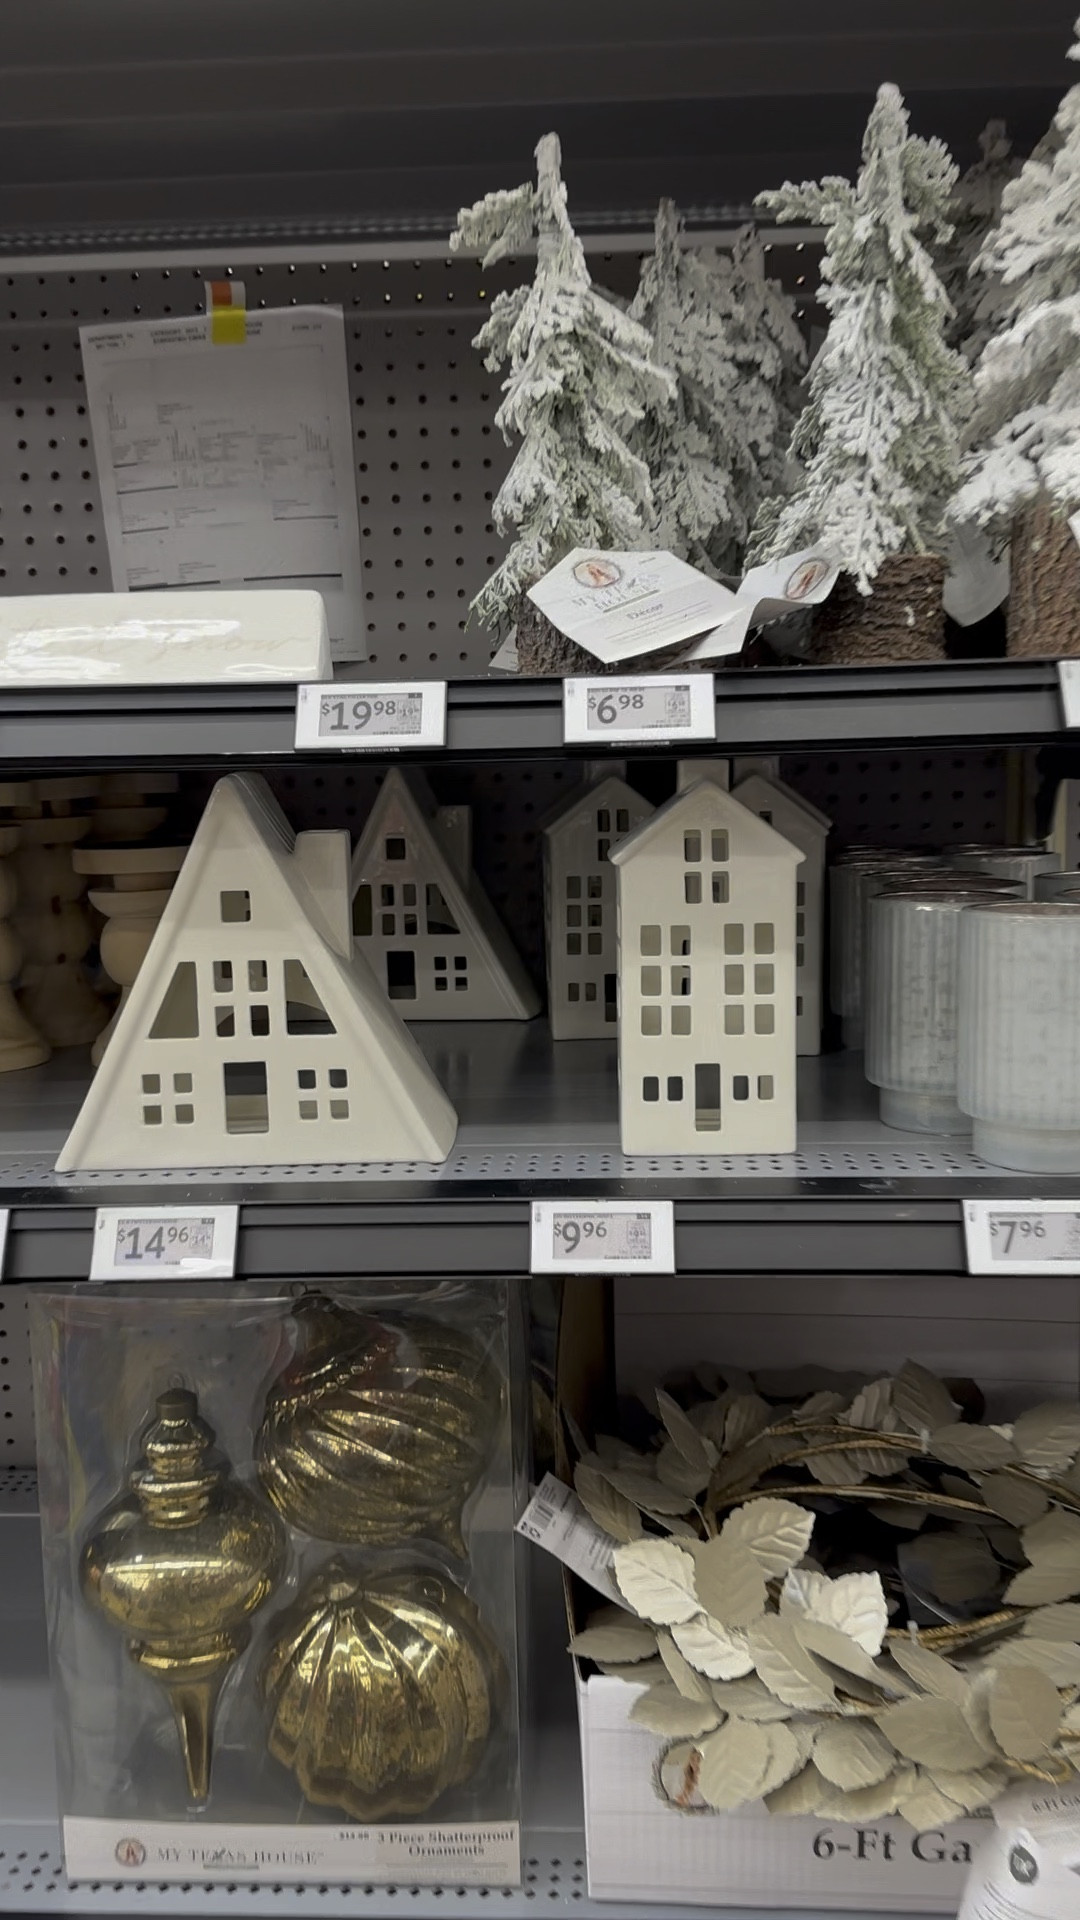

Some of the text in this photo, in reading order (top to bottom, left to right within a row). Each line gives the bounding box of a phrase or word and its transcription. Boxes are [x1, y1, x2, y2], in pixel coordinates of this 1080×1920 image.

[390, 1831, 425, 1844] Piece
[428, 1828, 514, 1845] Shatterproof
[408, 1845, 485, 1857] Ornaments
[812, 1827, 974, 1864] 6-Ft Ga
[158, 1847, 182, 1863] MY
